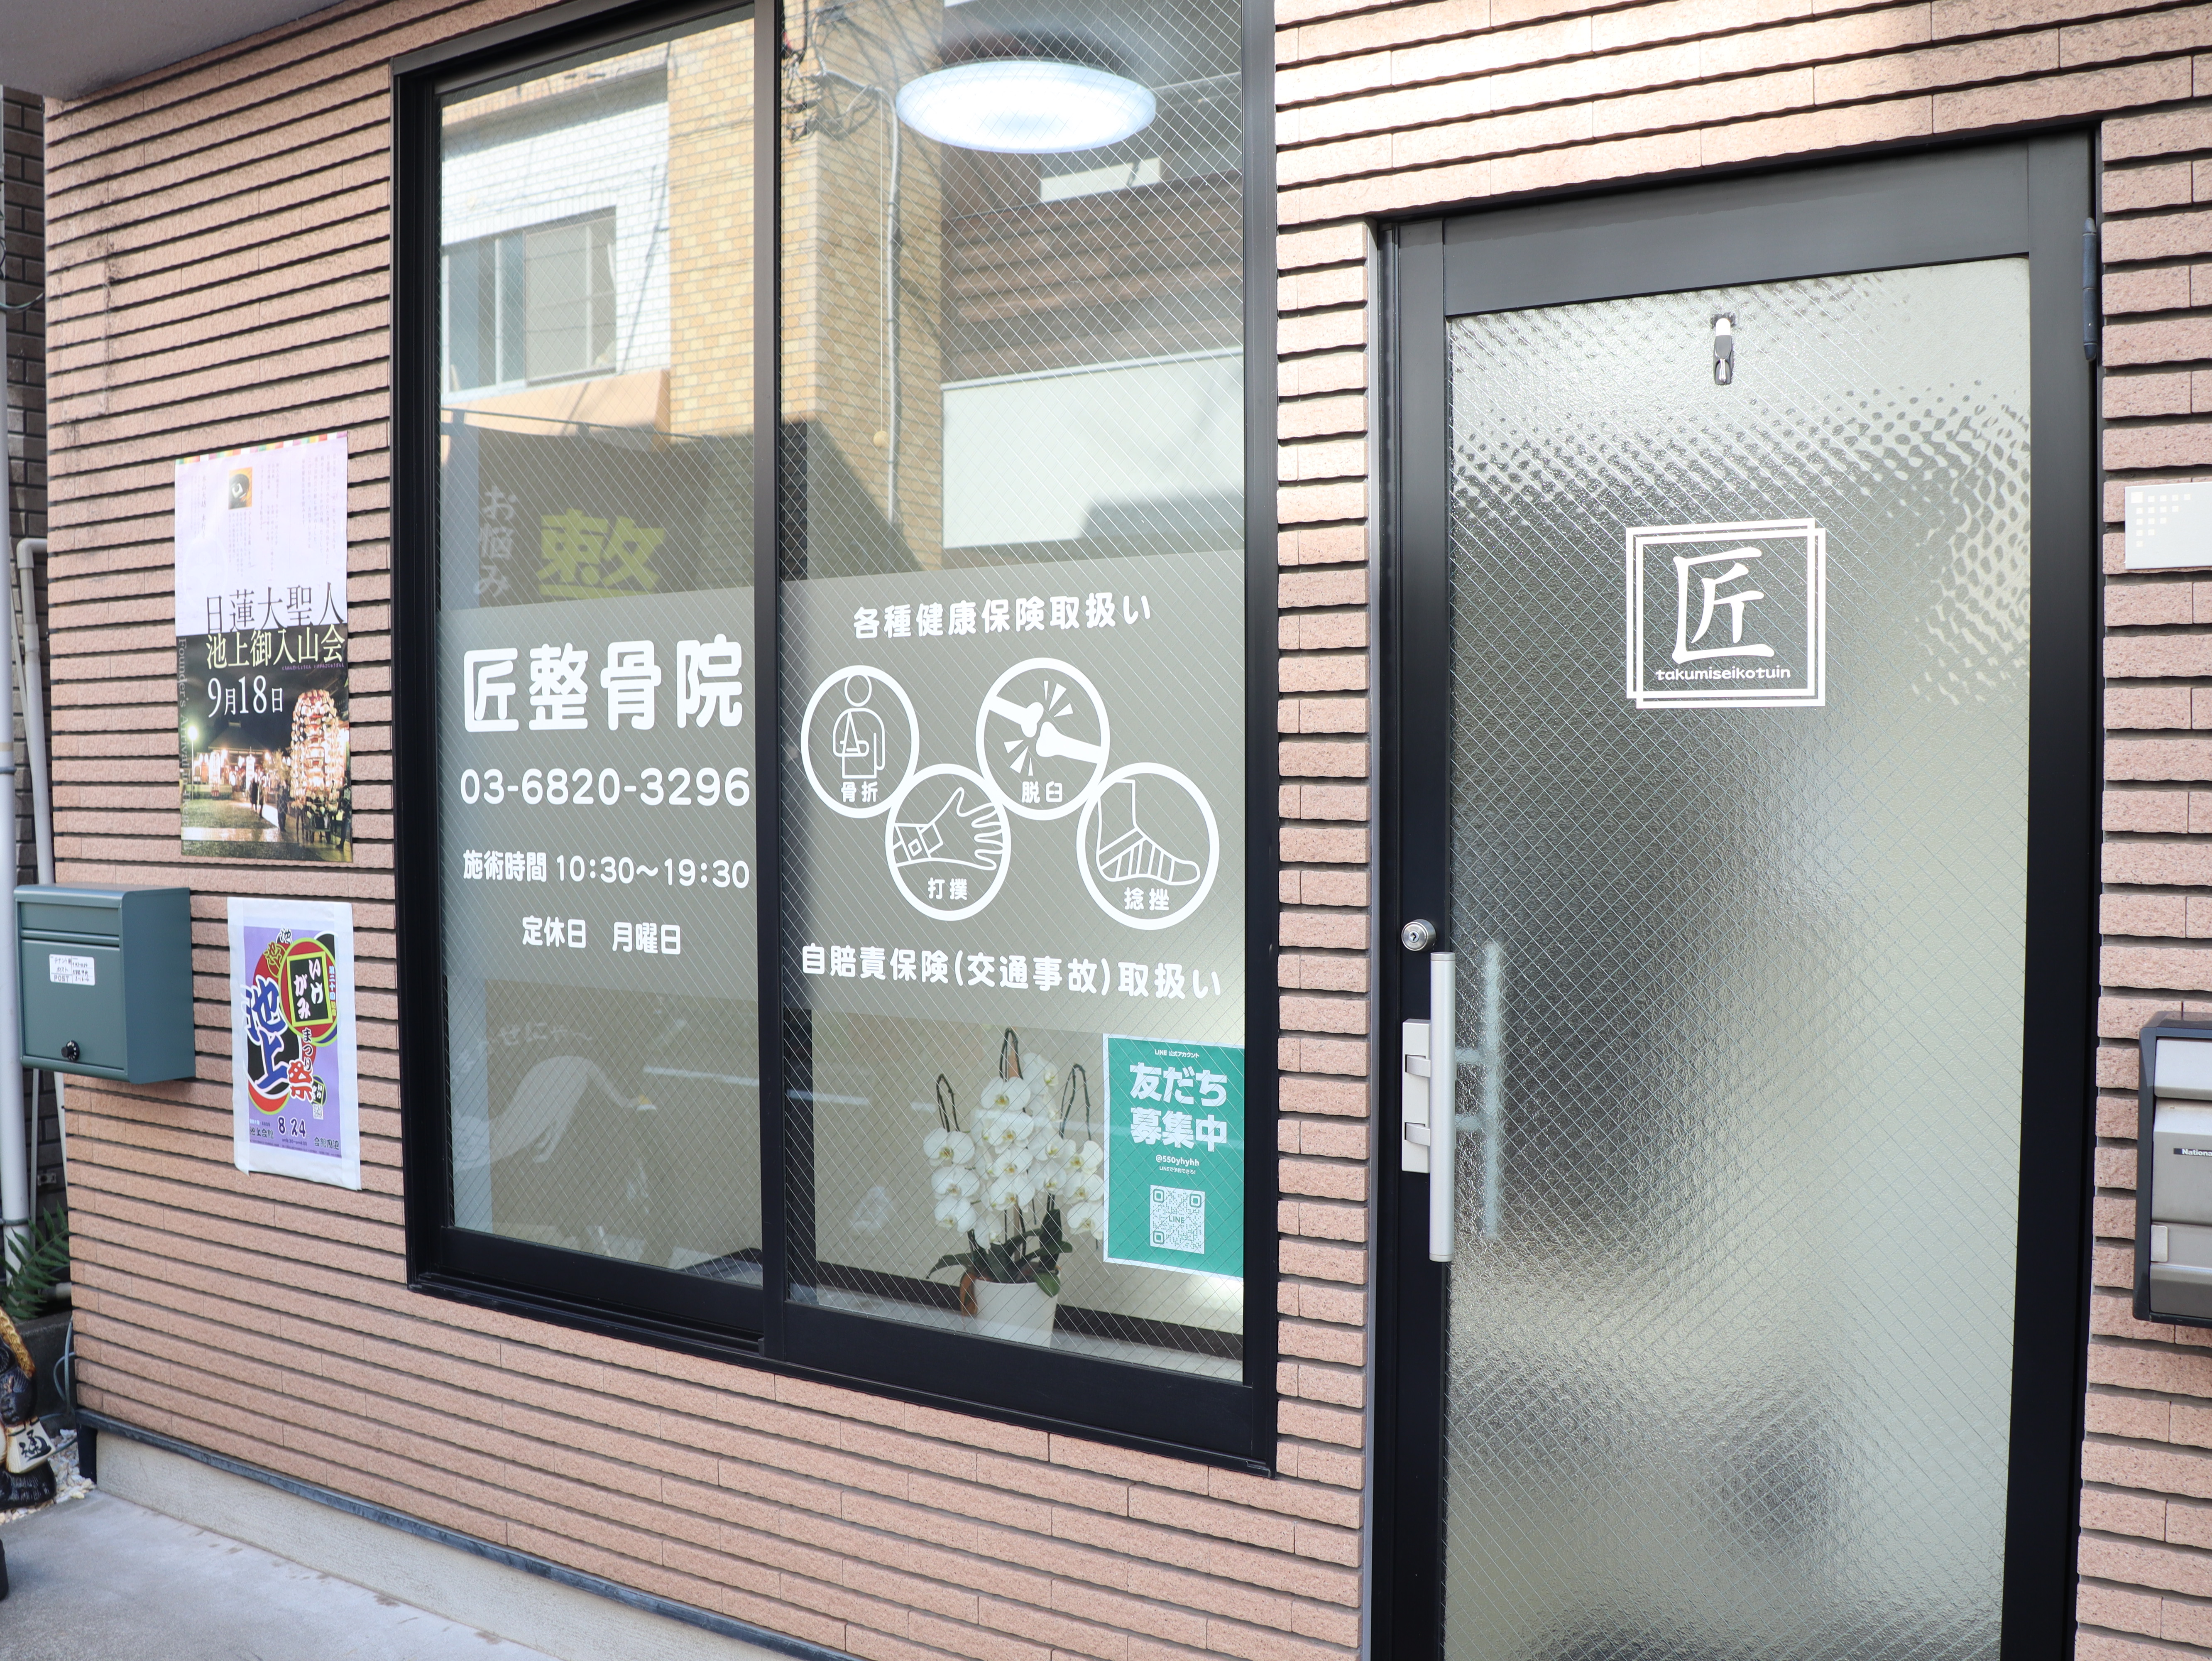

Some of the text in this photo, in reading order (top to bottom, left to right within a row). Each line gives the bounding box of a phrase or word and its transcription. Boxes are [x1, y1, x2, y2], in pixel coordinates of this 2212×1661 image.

[207, 582, 345, 633] 日蓮大聖人
[853, 592, 1150, 639] 各種健康保険取扱い
[1671, 547, 1775, 664] 匠
[206, 624, 345, 669] 池上御入山会
[178, 637, 188, 708] Founder's
[463, 633, 743, 733] 匠整骨院
[1655, 665, 1791, 681] takumiseikotuin
[208, 675, 283, 718] 9月18日
[180, 713, 190, 767] Arrival
[460, 767, 750, 806] 03-6820-3296
[841, 781, 878, 803] 骨折
[1021, 781, 1063, 804] 脱臼
[462, 849, 547, 882] 施術時間
[927, 877, 967, 900] 打撲
[1124, 887, 1170, 911] 捻挫
[522, 915, 681, 955] 定休日 月曜日
[302, 1027, 313, 1071] まつり
[1169, 1050, 1200, 1058] 公式アカウント
[288, 1060, 314, 1103] 祭
[1130, 1062, 1227, 1107] 友だち
[1130, 1107, 1227, 1152] 募集中
[1155, 1154, 1200, 1167] @550yhyhh
[1168, 1215, 1185, 1224] LINE
